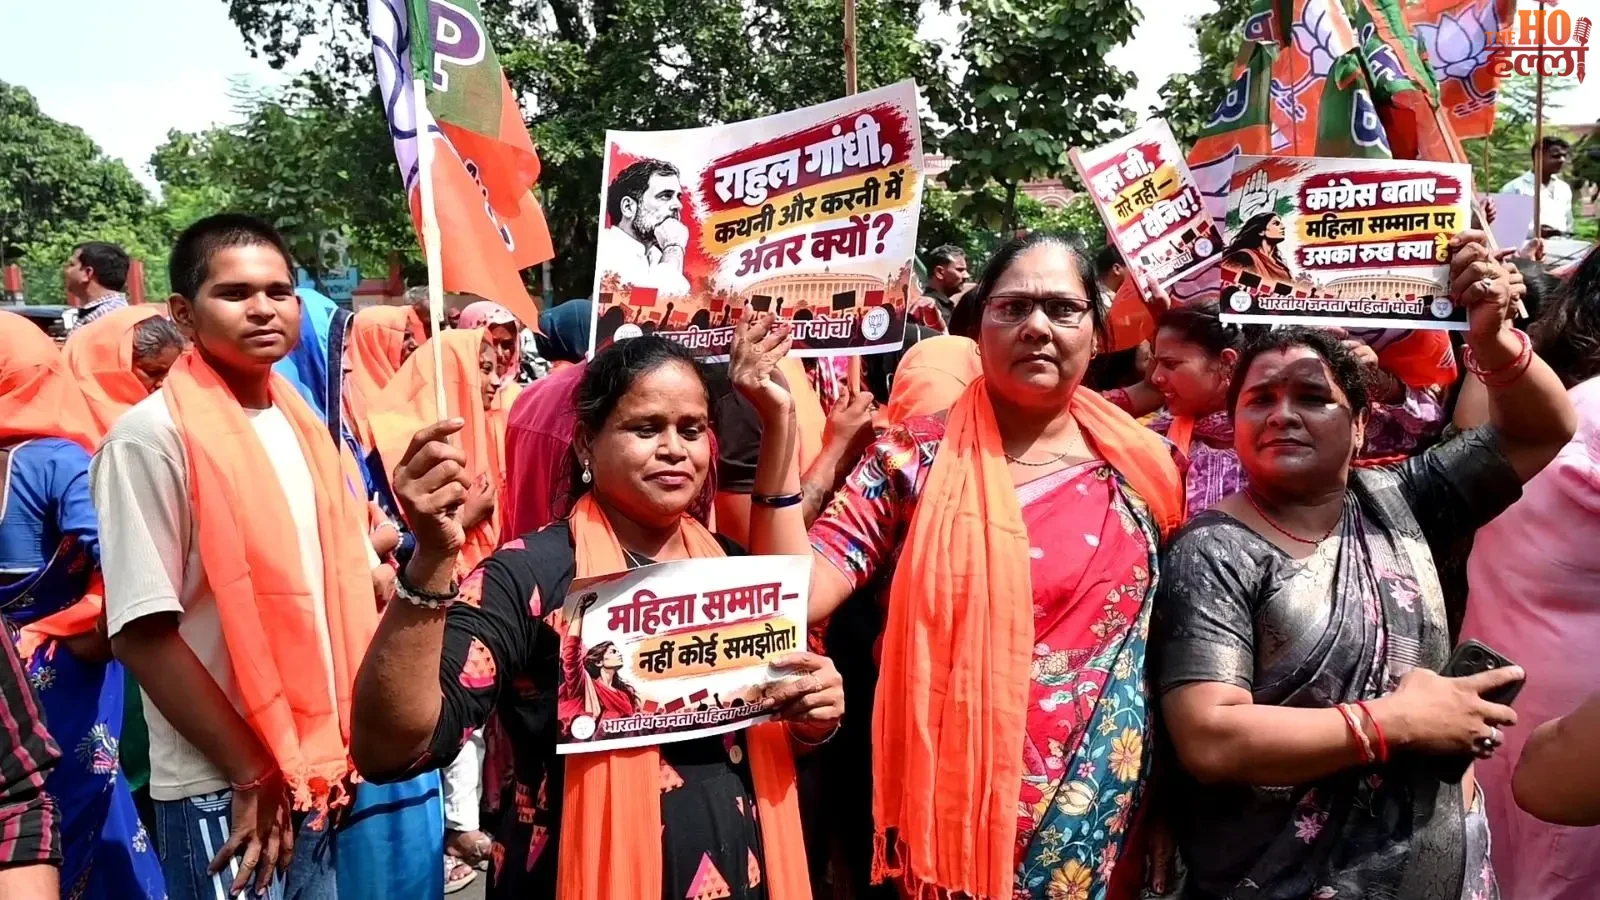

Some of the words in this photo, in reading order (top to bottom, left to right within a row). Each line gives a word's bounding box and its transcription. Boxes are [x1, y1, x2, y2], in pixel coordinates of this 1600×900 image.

[714, 150, 801, 207] राहुल
[803, 113, 893, 177] गांधी,
[715, 208, 776, 247] कथनी
[779, 194, 814, 226] और
[821, 177, 880, 216] करनी
[883, 168, 905, 200] में
[1305, 178, 1376, 211] कांग्रेस
[1305, 212, 1364, 239] महिला
[1368, 213, 1429, 234] सम्मान
[1434, 211, 1456, 229] पर
[735, 234, 805, 278] अंतर
[810, 213, 894, 262] क्यों?
[1302, 244, 1356, 266] उसका
[1359, 242, 1394, 263] रुख
[1397, 240, 1434, 261] क्या
[1258, 295, 1306, 311] भारतीय
[1309, 297, 1345, 312] जनता
[1347, 295, 1389, 314] महिला
[1391, 296, 1424, 314] मोर्चा
[808, 313, 853, 339] मोर्चा
[607, 588, 697, 637] महिला
[639, 640, 676, 673] नहीं
[678, 633, 719, 668] कोई
[723, 623, 797, 660] समझौता!
[603, 714, 654, 734] भारतीय
[655, 712, 695, 729] जनता
[695, 704, 736, 725] महिला
